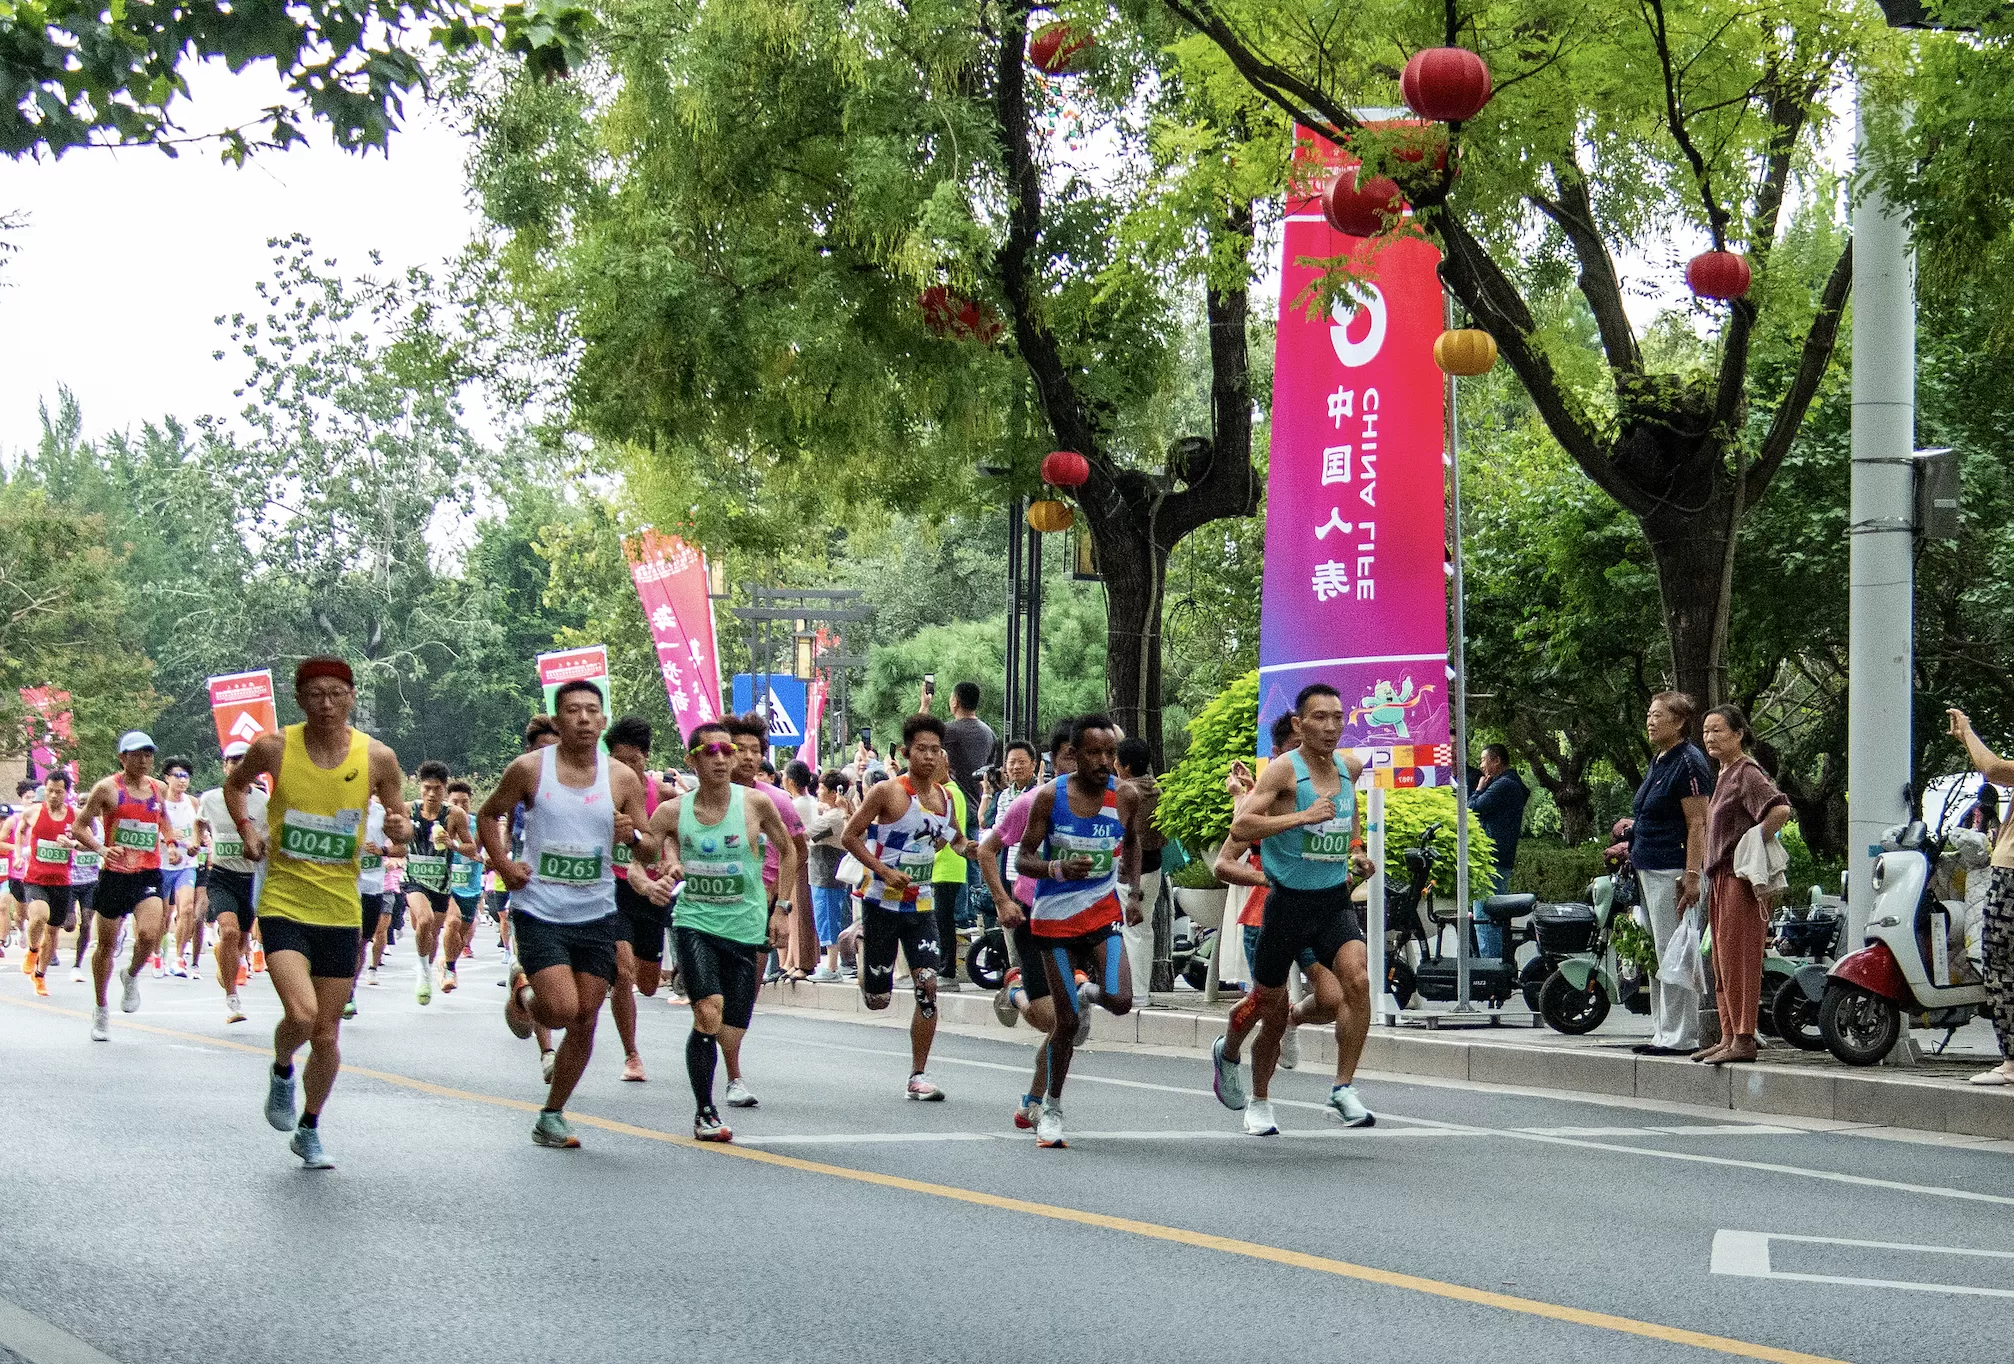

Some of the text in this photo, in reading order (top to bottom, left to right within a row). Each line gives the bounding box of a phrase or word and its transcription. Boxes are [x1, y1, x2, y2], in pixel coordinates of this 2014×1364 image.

[121, 831, 153, 846] 0035
[288, 829, 347, 856] 0043
[40, 848, 66, 860] 0033
[216, 845, 240, 855] 002
[362, 857, 378, 869] 37
[413, 864, 442, 874] 0042
[547, 857, 595, 877] 0265
[688, 877, 736, 894] 0002
